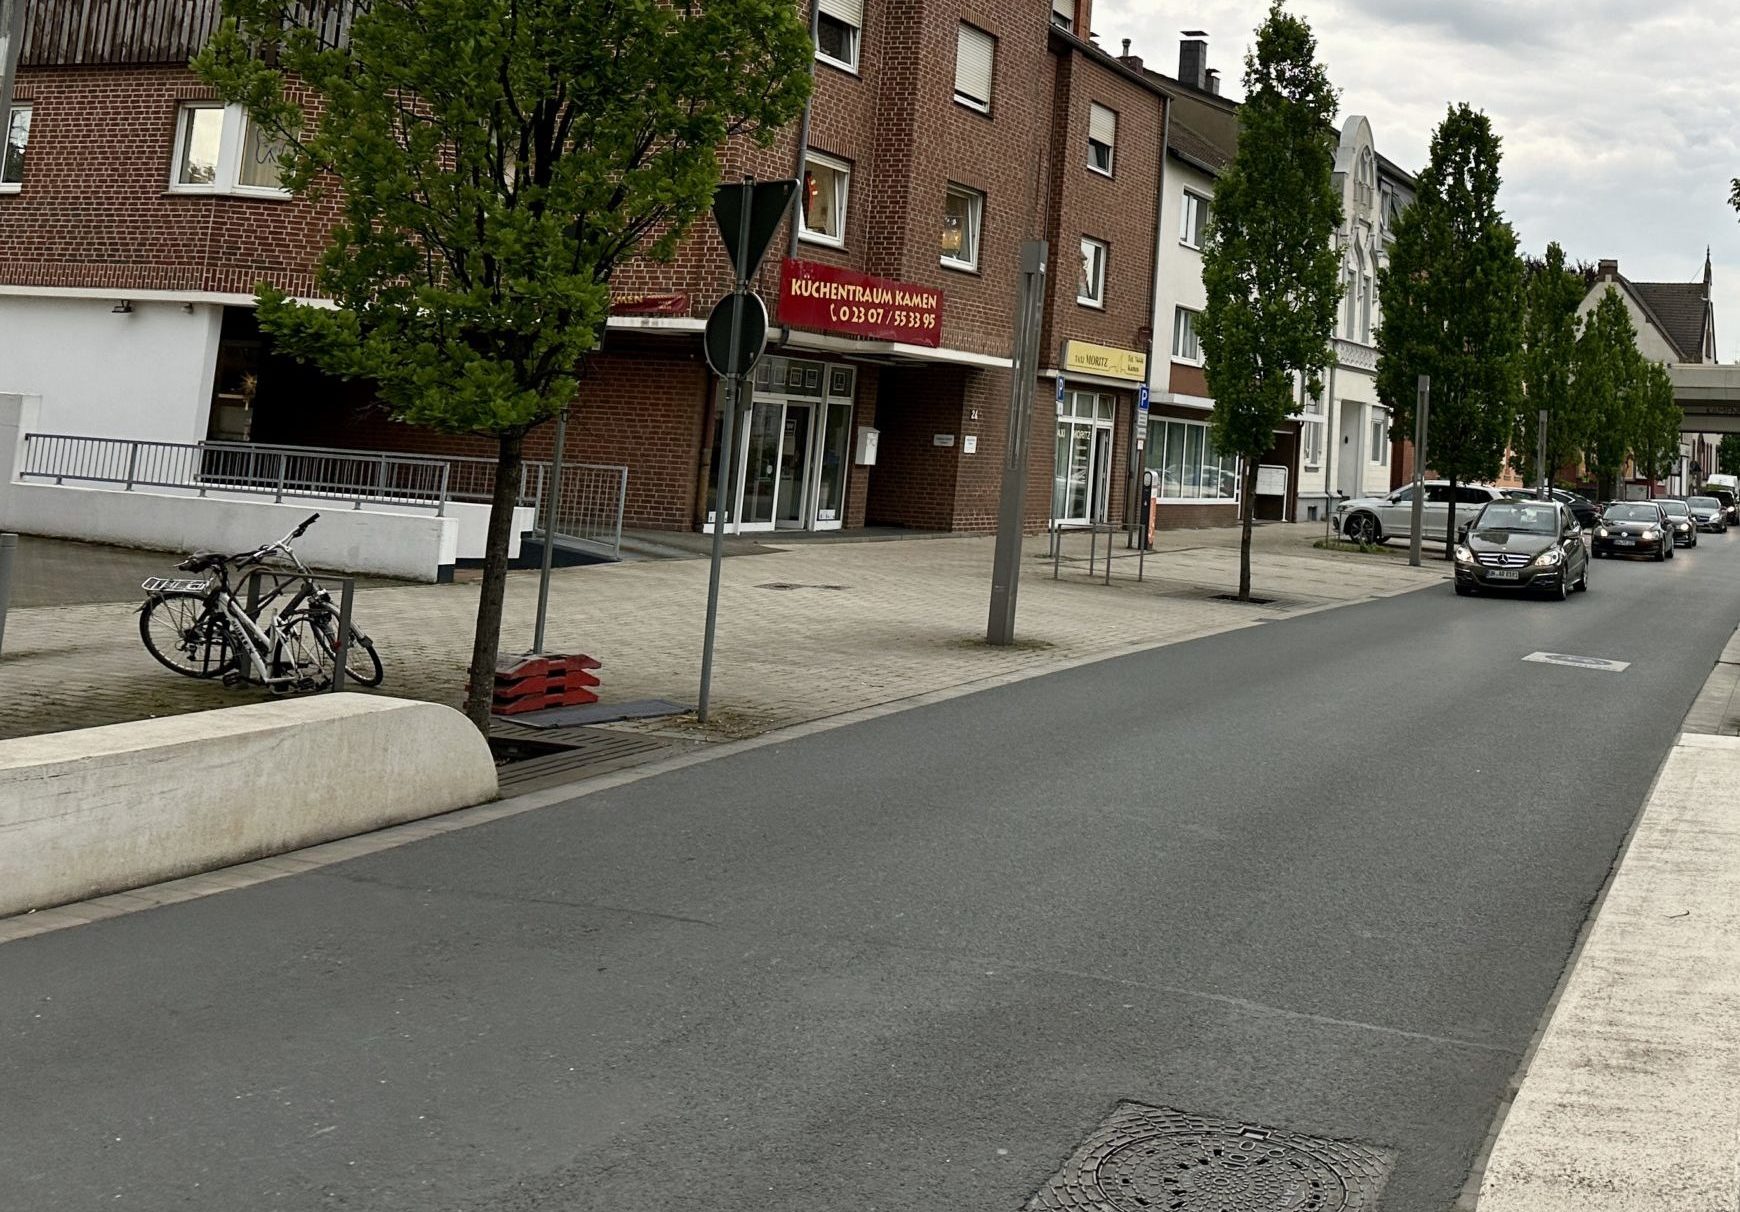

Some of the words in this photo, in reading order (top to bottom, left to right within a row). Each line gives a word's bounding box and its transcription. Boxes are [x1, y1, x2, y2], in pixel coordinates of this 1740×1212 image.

[615, 295, 643, 304] MEN
[791, 274, 893, 304] KÜCHENTRAUM
[895, 290, 937, 309] KAMEN
[839, 308, 850, 322] 0
[851, 307, 865, 323] 23
[867, 308, 884, 324] 07
[894, 310, 907, 327] 55
[908, 312, 920, 328] 33
[923, 313, 935, 329] 95
[1086, 354, 1109, 368] MORITZ
[1141, 389, 1148, 406] P
